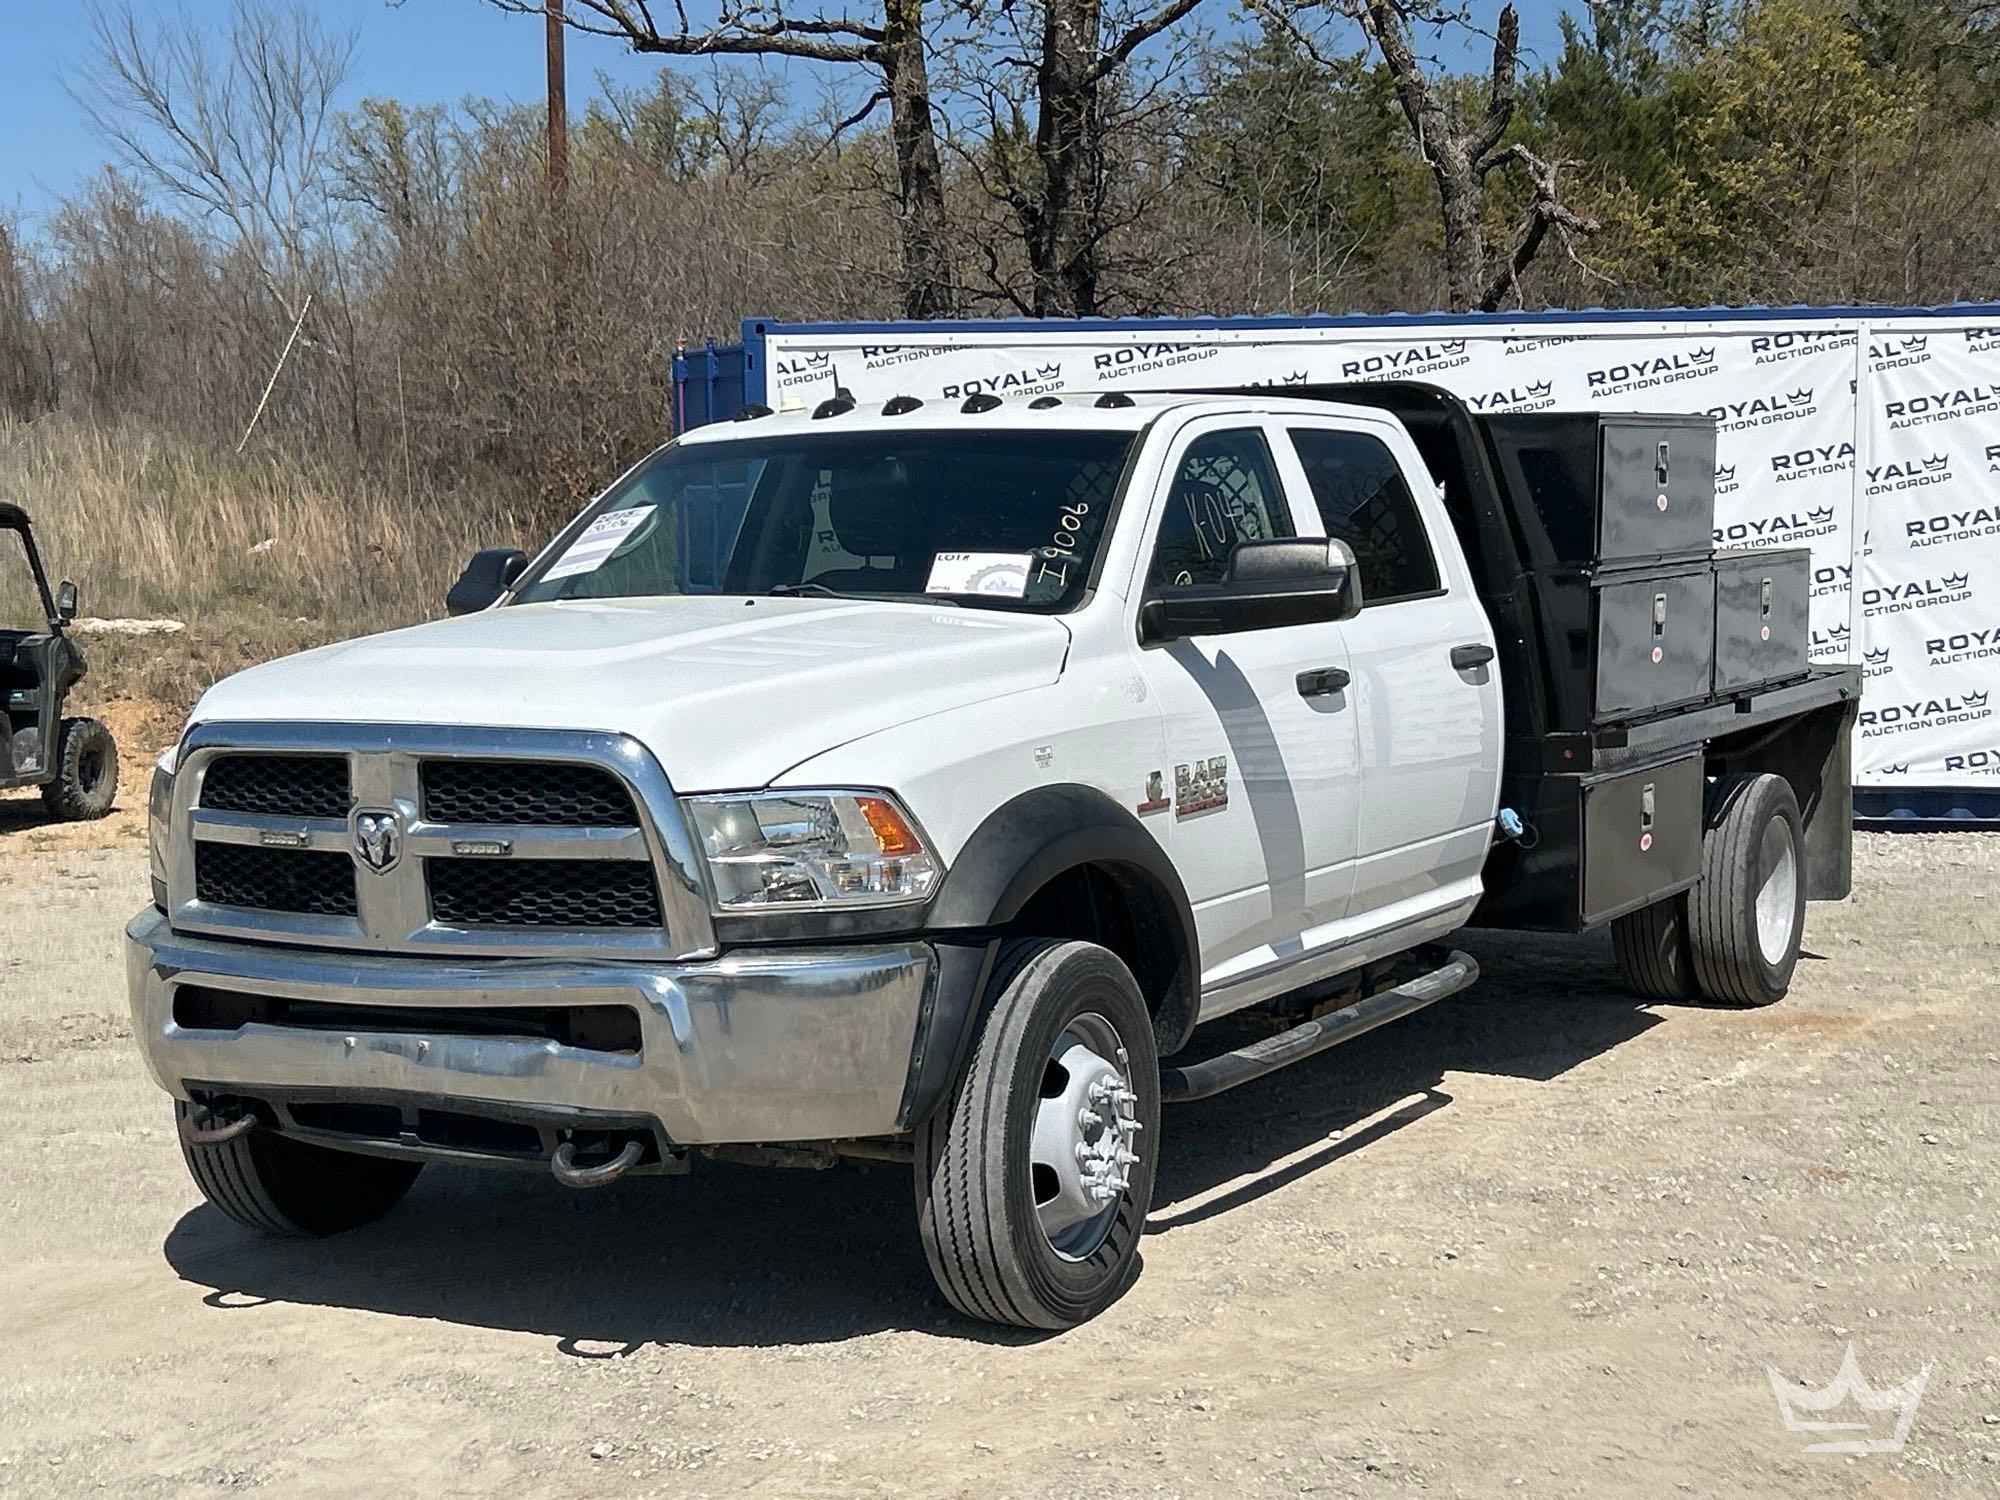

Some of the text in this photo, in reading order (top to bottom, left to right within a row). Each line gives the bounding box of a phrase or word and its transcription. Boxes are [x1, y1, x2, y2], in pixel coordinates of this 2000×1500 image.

[1505, 336, 1575, 355] AUCTION
[1751, 330, 1858, 353] ROYA
[1755, 336, 1858, 365] AUCTION GRO
[866, 350, 930, 369] AUCTION
[1098, 349, 1218, 380] AUCTION GROUP
[1342, 346, 1441, 377] ROYAL
[1349, 356, 1470, 383] CTION GROUP
[1587, 355, 1689, 386] ROYAL
[1875, 353, 1932, 372] GROUP
[784, 369, 835, 387] GROUP
[942, 370, 1037, 399] ROYAL
[1591, 365, 1719, 399] AUCTION GROUP
[1470, 388, 1527, 410] YAL
[1707, 396, 1787, 421] OYAL
[1885, 387, 1991, 418] ROYAL
[1716, 406, 1817, 433] TION GROUP
[1889, 401, 2000, 430] AUCTION GRO
[1771, 442, 1856, 471] ROYA
[1775, 462, 1846, 482] AUCTION
[1865, 461, 1922, 483] YAL
[1896, 472, 1952, 490] GROUP
[1712, 513, 1807, 542] ROYAL
[1719, 524, 1838, 550] UCTION GROUP
[1910, 528, 1981, 549] AUCTION
[1862, 579, 1942, 605] OYAL
[1863, 591, 1972, 617] CTION GROUP
[1926, 628, 2000, 654] ROYA
[1930, 646, 2000, 667] AUCTION
[1862, 666, 1893, 678] OUP
[1859, 697, 1962, 726] ROYAL
[1861, 709, 1992, 738] AUCTION GROUP
[1174, 756, 1227, 787] RAM
[1945, 750, 2000, 771] ROY
